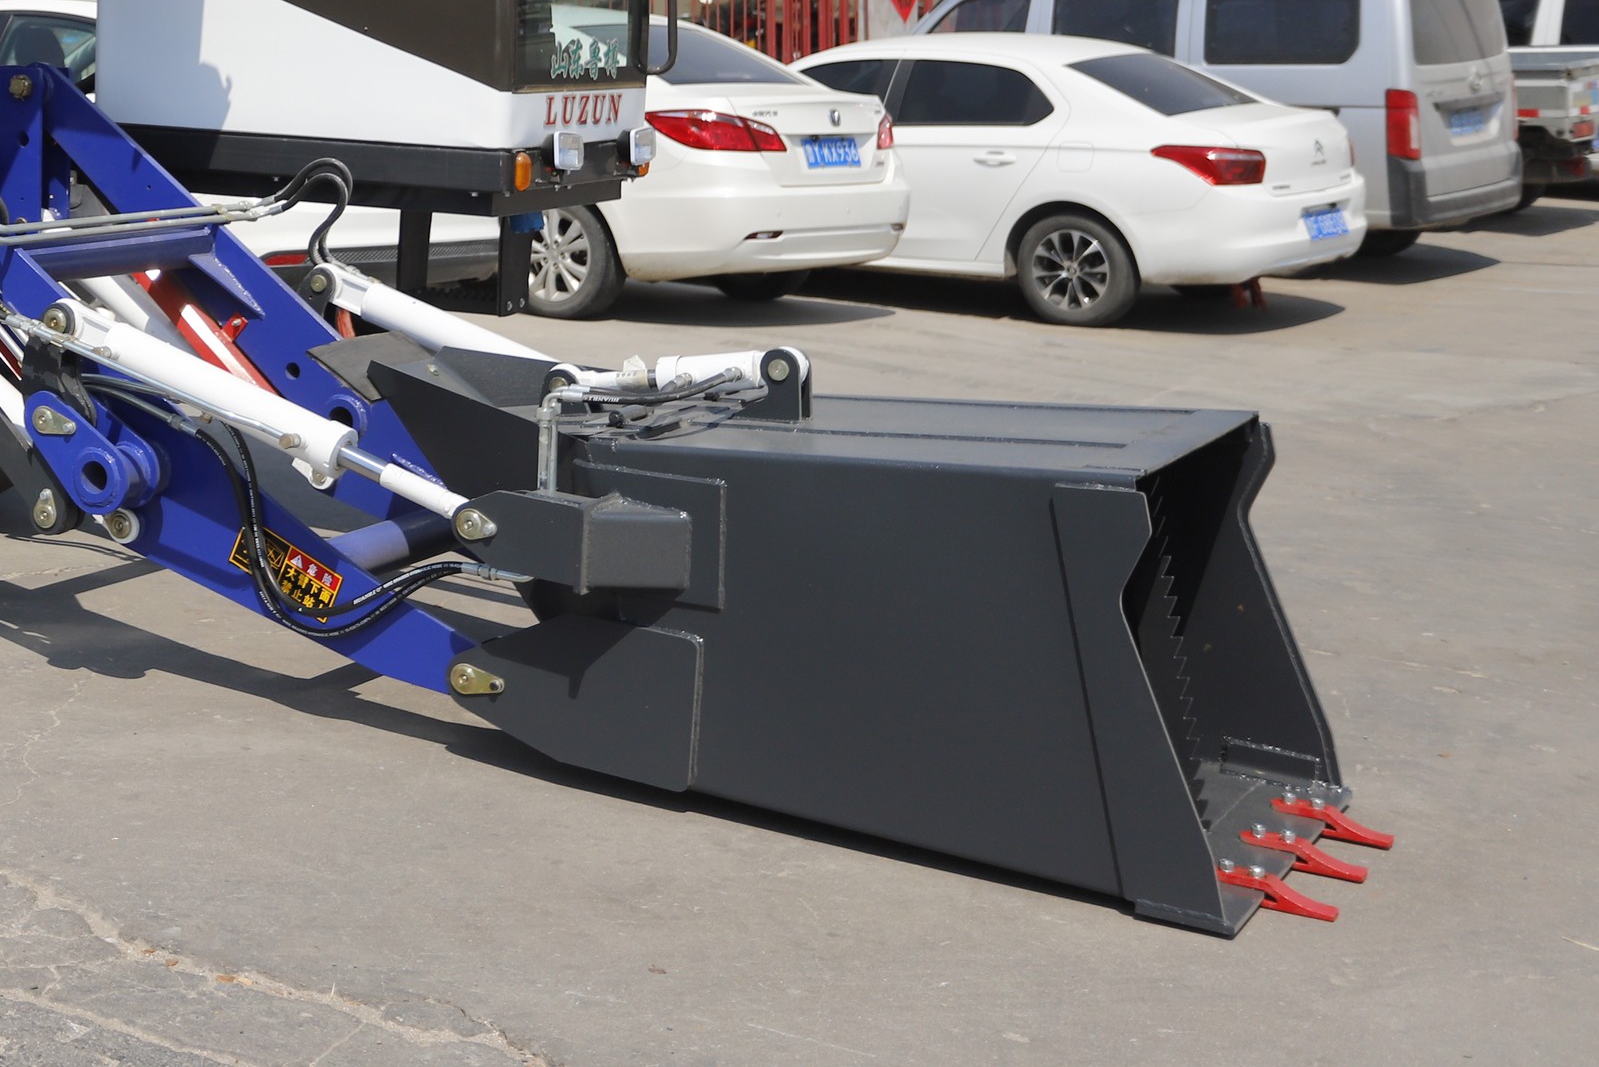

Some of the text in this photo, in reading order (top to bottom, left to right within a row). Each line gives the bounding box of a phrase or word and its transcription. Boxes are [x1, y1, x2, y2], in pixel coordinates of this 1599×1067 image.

[550, 38, 620, 81] 山东鲁樽
[545, 94, 622, 126] LUZUN
[307, 563, 333, 587] 危险
[281, 580, 324, 609] 禁止站
